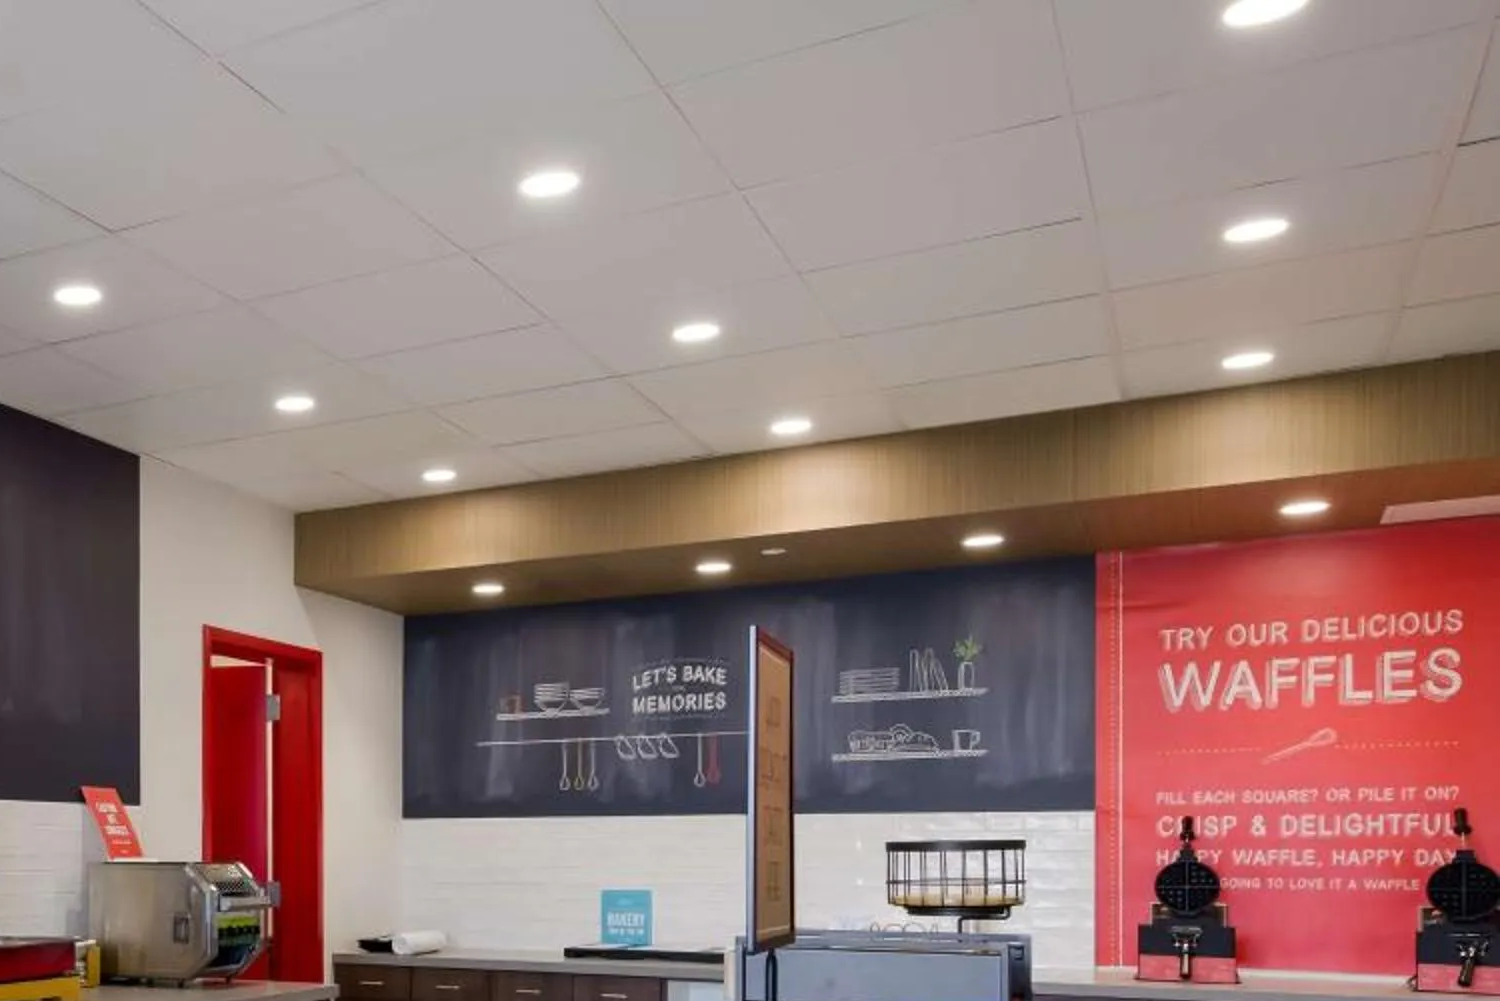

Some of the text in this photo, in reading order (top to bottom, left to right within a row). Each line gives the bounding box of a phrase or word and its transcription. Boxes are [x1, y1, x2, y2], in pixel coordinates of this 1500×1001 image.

[1160, 609, 1464, 651] TRY OUR DELICIOUS
[632, 664, 728, 693] LET'S BAKE
[1158, 647, 1464, 712] WAFFLES
[632, 691, 727, 714] MEMORIES
[1156, 785, 1460, 805] FILL EACH SQUARE? OR PILE IT ON?
[1251, 814, 1267, 838] &
[1280, 812, 1456, 837] DELIGHTFUL
[1156, 848, 1223, 865] HAPY
[1232, 848, 1324, 868] WAFFLE,
[1331, 848, 1404, 867] HAPPY
[1267, 877, 1284, 890] TO
[1289, 877, 1324, 891] LOVE
[1329, 877, 1342, 891] IT
[1346, 879, 1358, 891] A
[1363, 878, 1420, 891] WAFFLE
